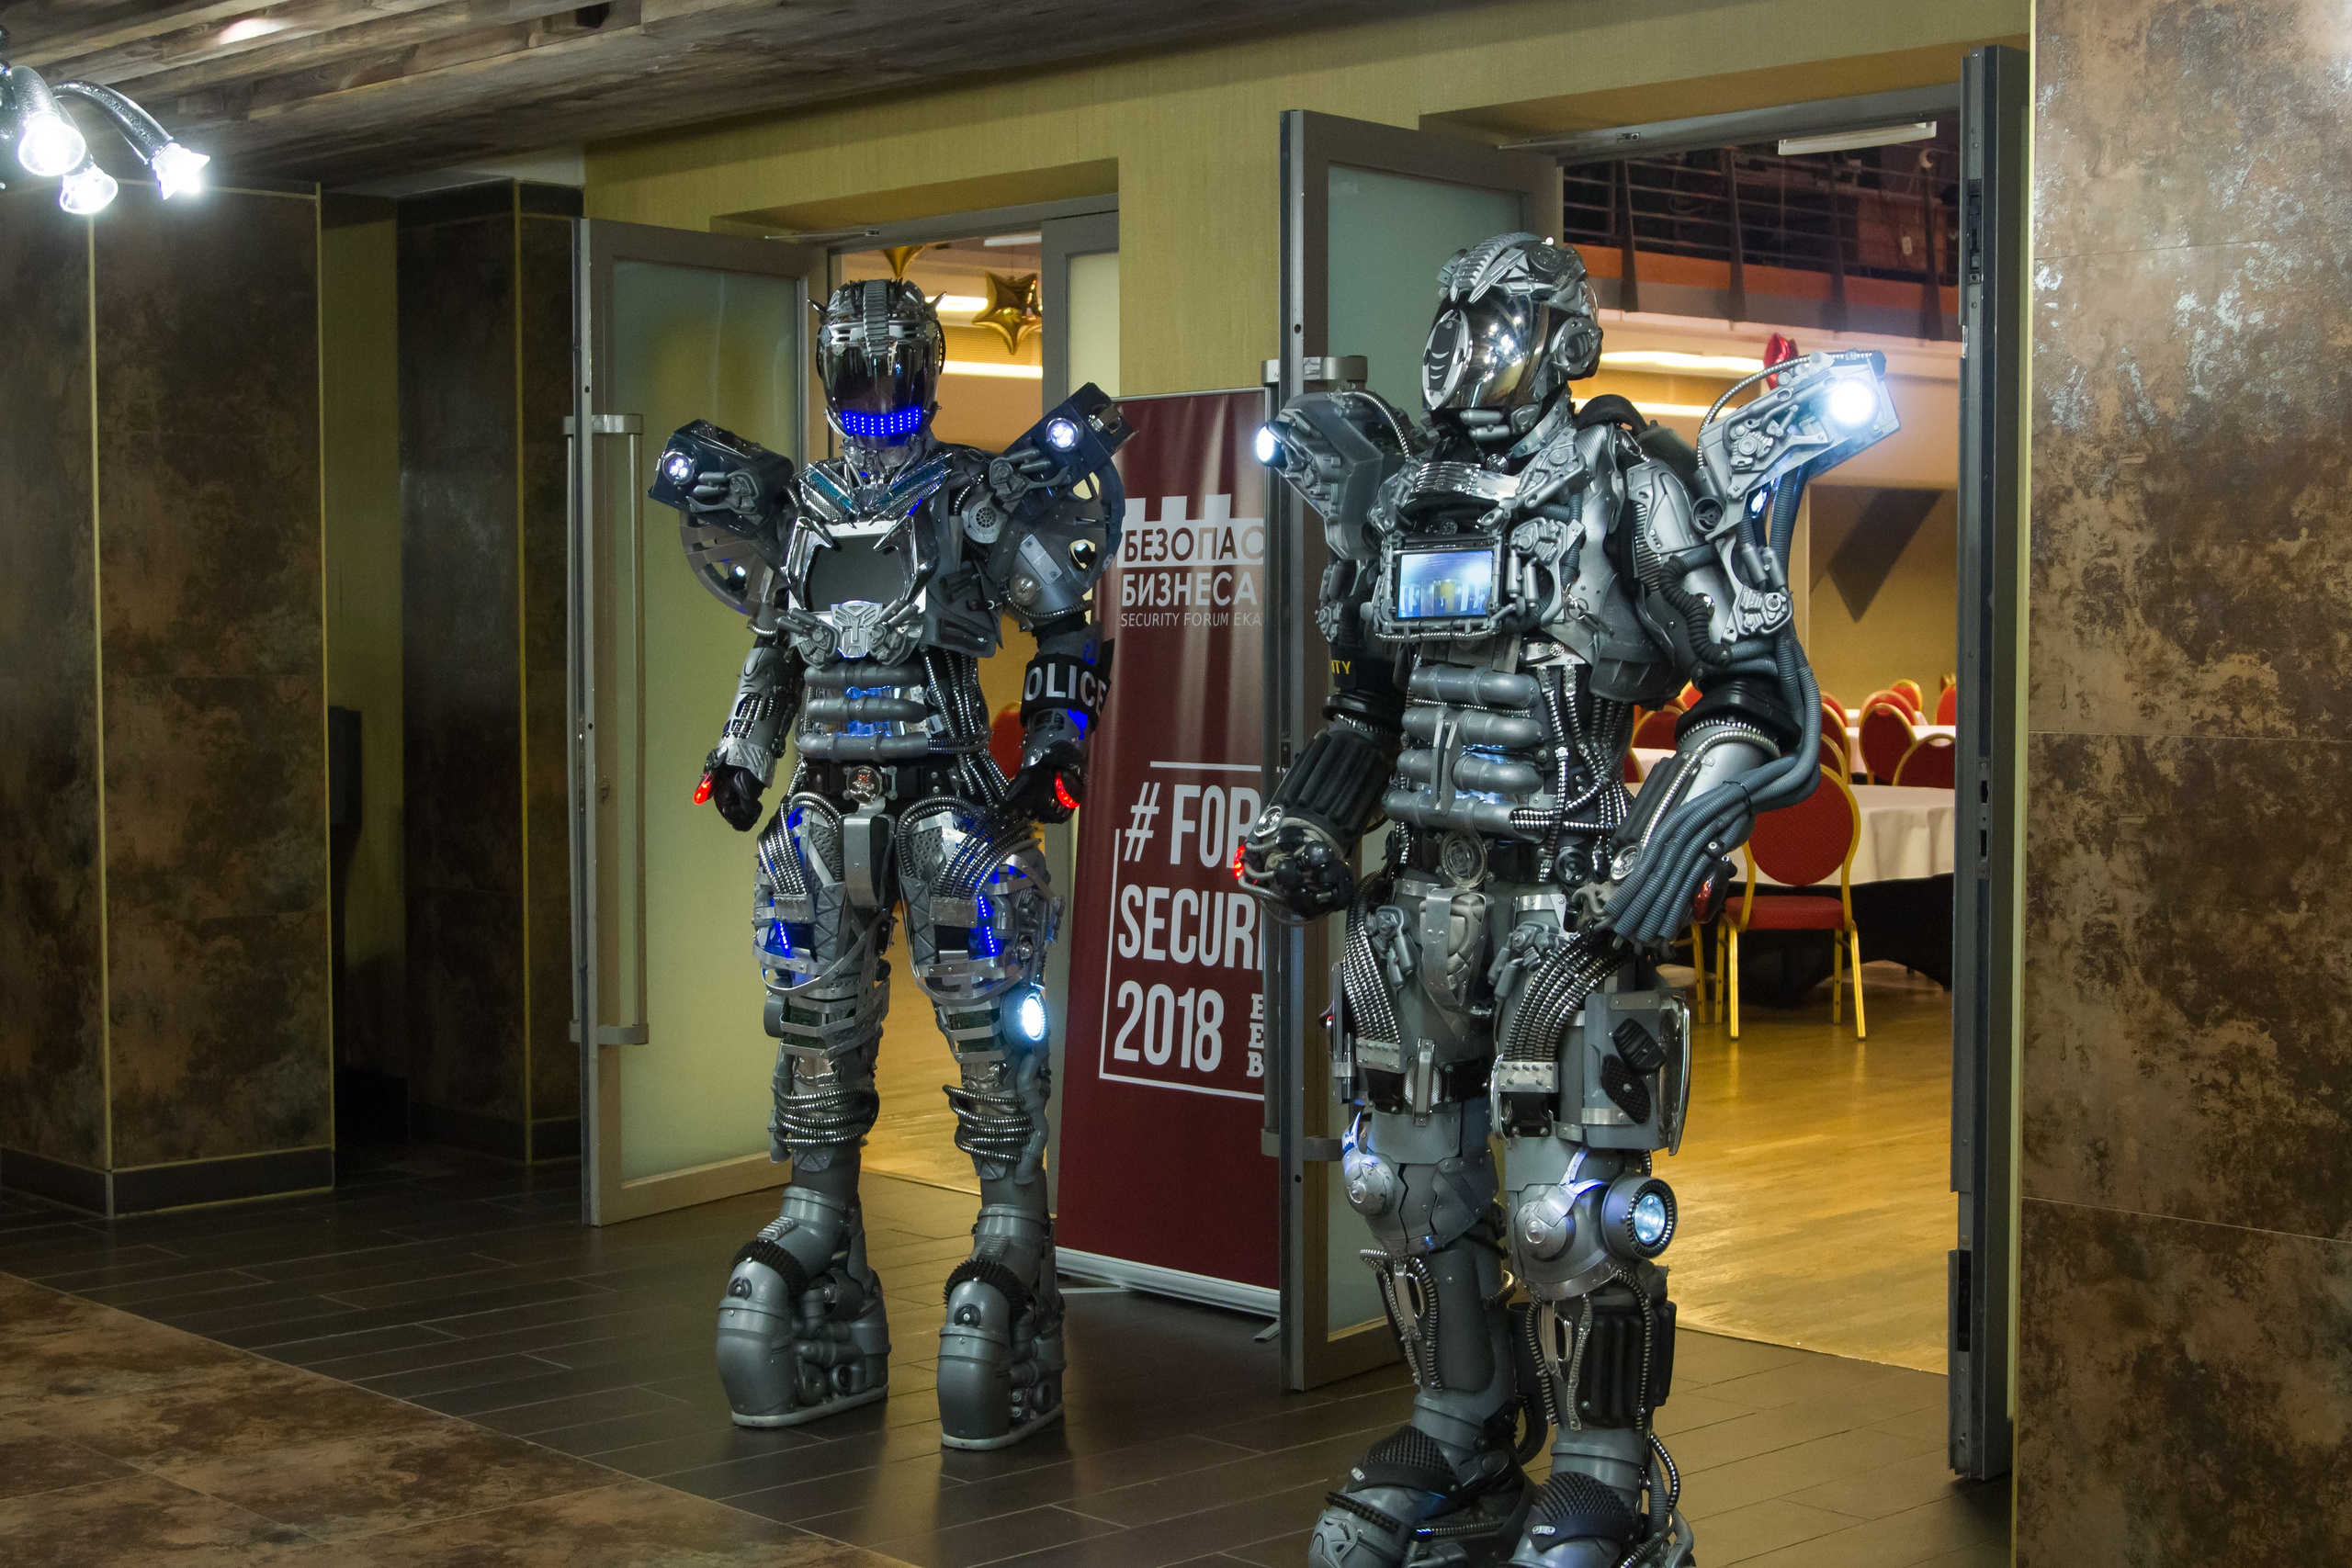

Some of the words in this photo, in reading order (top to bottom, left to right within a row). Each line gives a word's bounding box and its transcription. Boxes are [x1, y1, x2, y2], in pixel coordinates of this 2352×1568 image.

[1124, 525, 1264, 562] БЕЗОПАС
[1122, 571, 1258, 607] БИЗНЕСА
[1121, 613, 1180, 626] SECURITY
[1183, 613, 1229, 626] FORUM
[1234, 612, 1262, 626] EKA
[1114, 980, 1225, 1073] 2018
